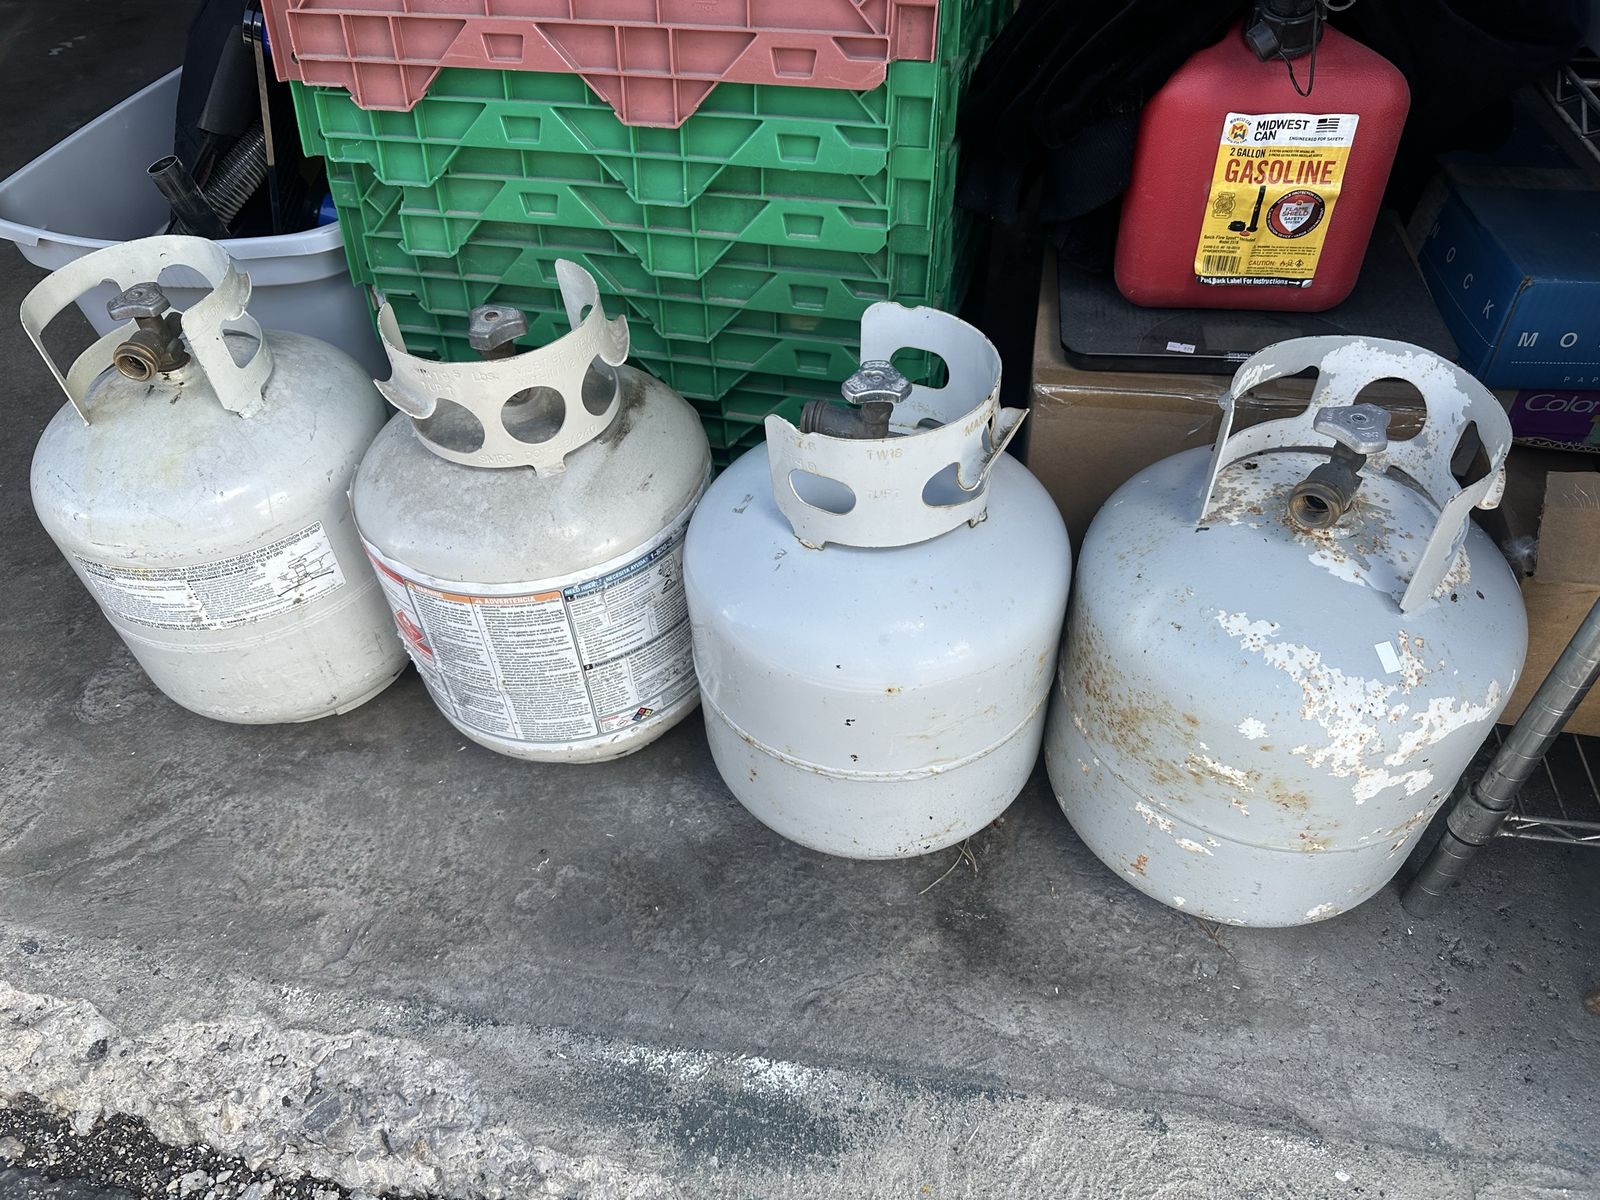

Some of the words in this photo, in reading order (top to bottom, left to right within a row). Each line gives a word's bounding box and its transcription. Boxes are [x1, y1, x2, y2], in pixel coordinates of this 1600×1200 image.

[1256, 120, 1310, 131] MIDWEST
[1254, 130, 1277, 141] CAN
[1230, 148, 1235, 157] 2
[1237, 148, 1266, 158] GALLON
[1225, 159, 1336, 185] GASOLINE
[275, 533, 300, 547] EXPLOSION
[304, 522, 320, 533] IGNITED
[199, 566, 221, 574] CYLINDER
[280, 537, 301, 551] OUTDOOR
[484, 595, 536, 605] ADVERTENCIA
[594, 659, 610, 668] Always
[610, 653, 624, 663] Check
[631, 645, 644, 655] Leaks
